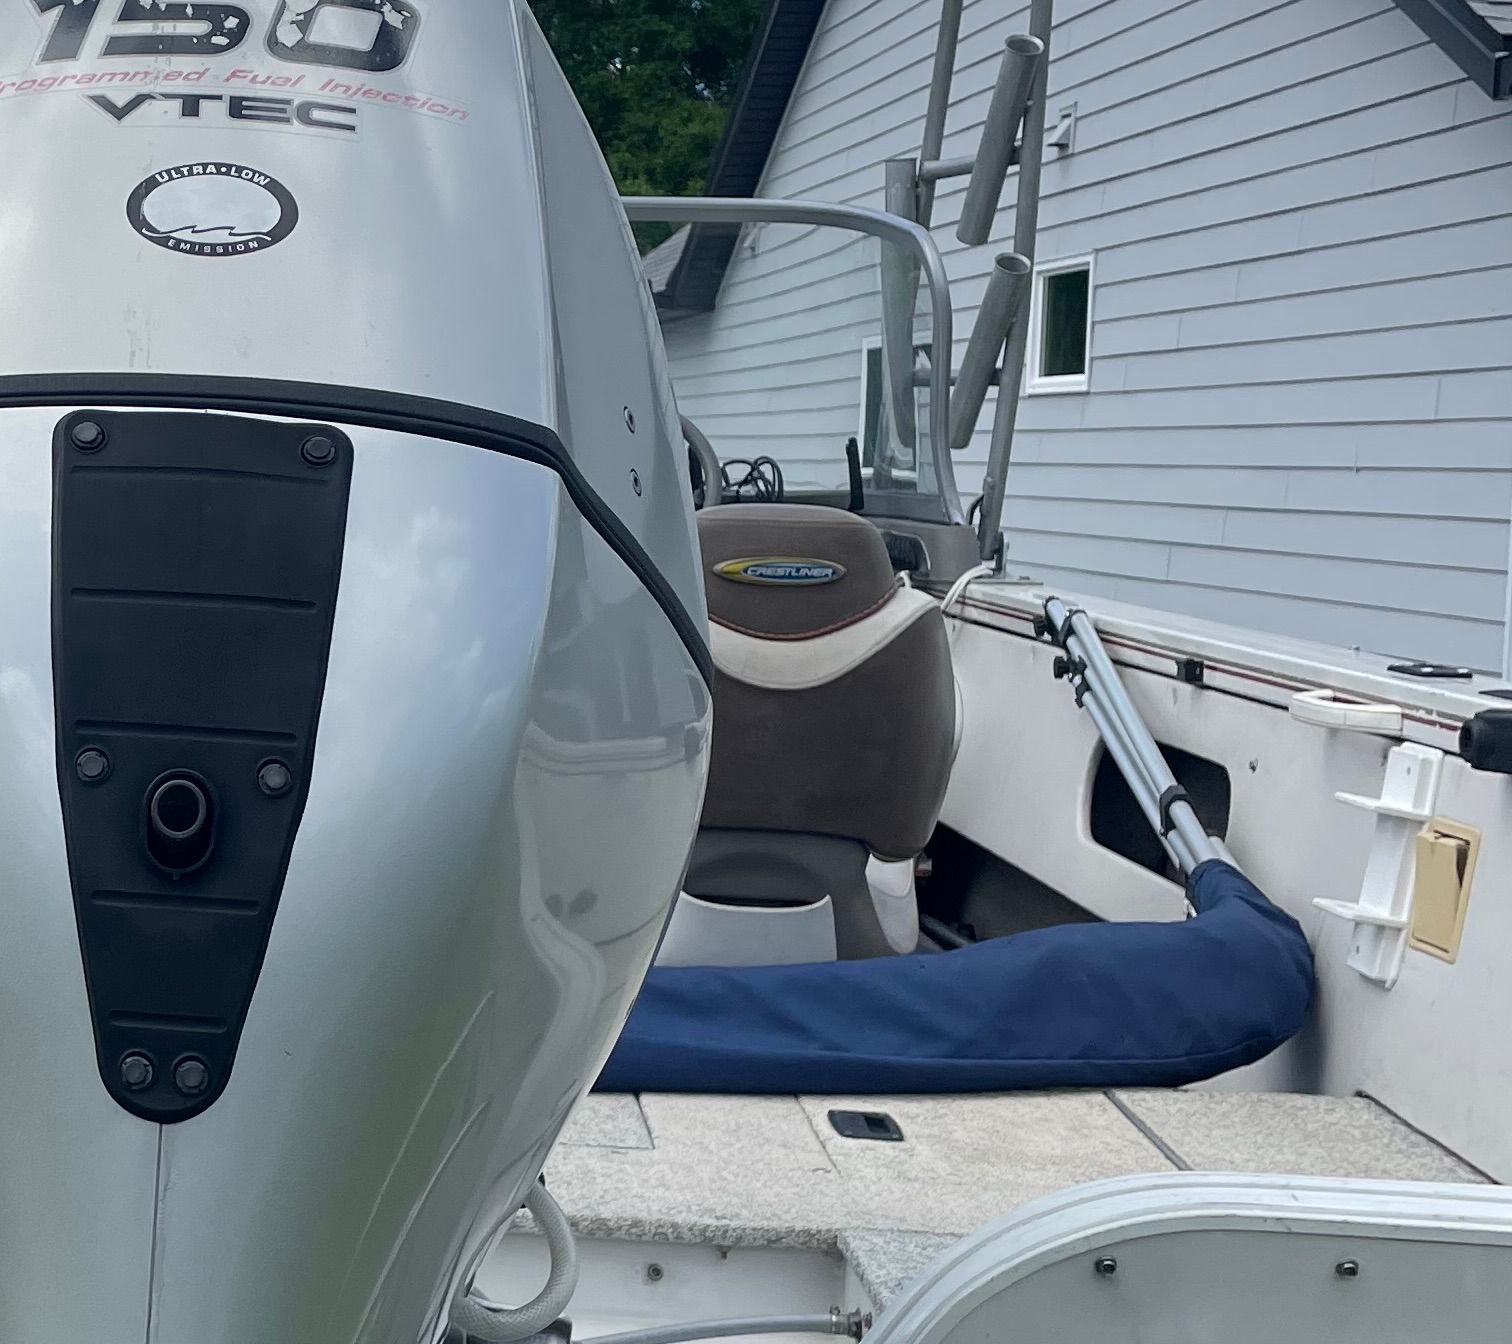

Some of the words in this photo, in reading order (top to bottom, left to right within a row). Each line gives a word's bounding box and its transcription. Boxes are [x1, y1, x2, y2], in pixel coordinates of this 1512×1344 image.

[222, 68, 306, 88] Fuel
[318, 77, 471, 121] Injection
[87, 93, 357, 132] VTEC
[167, 239, 259, 253] EMISSION
[747, 566, 834, 578] CRESTLINER
